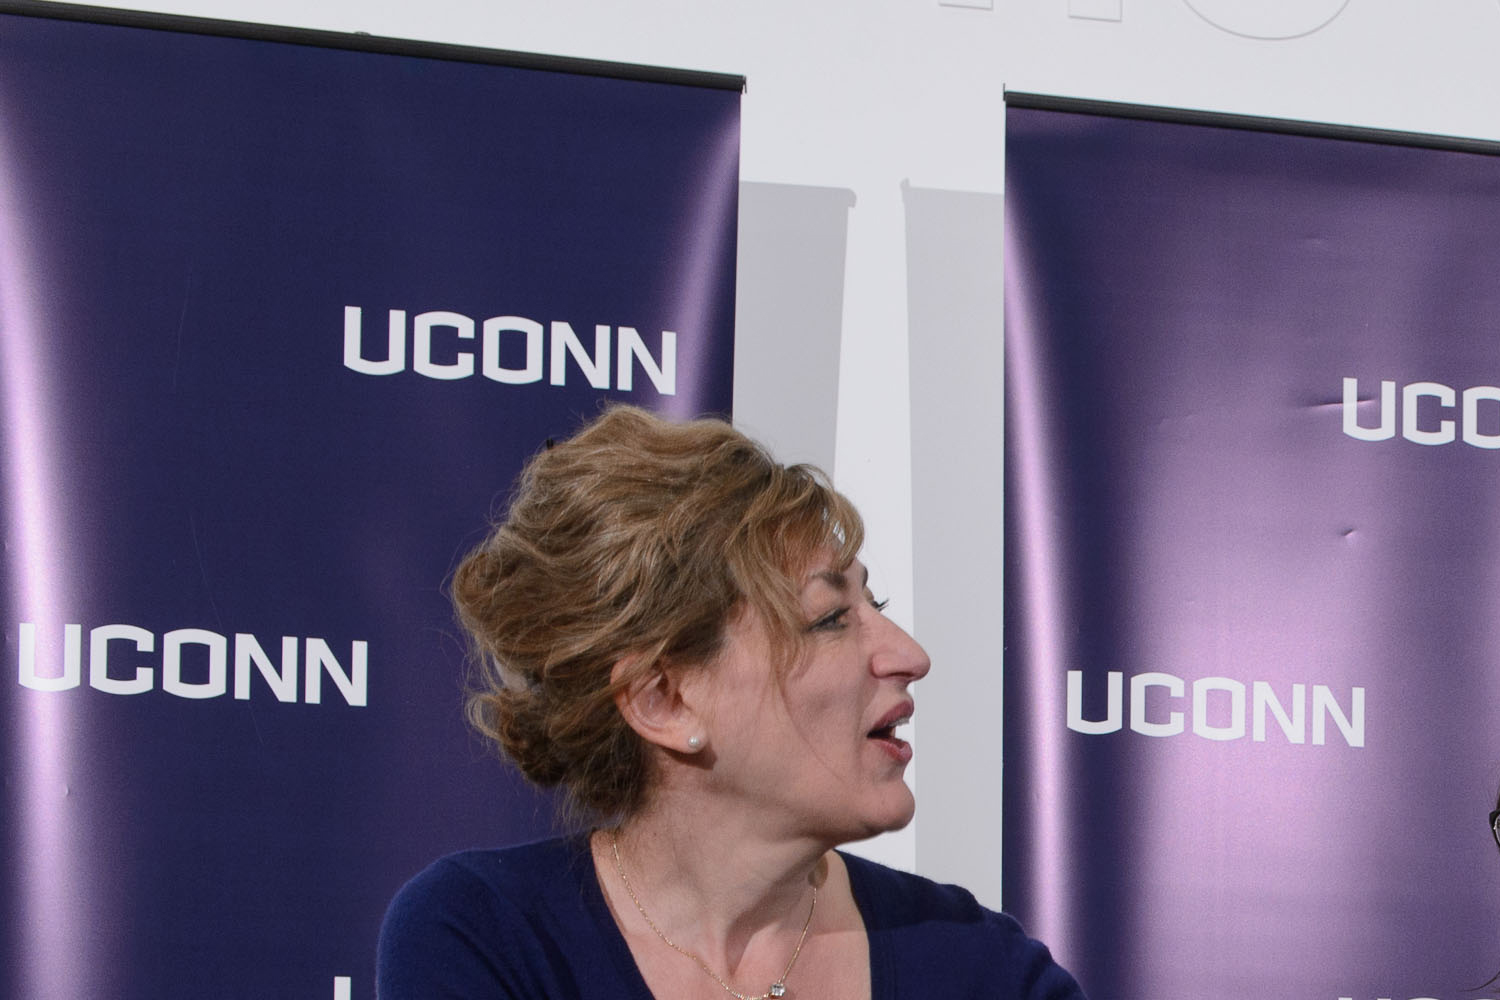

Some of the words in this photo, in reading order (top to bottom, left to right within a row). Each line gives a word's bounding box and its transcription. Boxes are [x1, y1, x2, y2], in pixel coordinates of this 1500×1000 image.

[343, 306, 677, 396] UCONN
[18, 622, 368, 707] UCONN
[1066, 670, 1365, 748] UCONN
